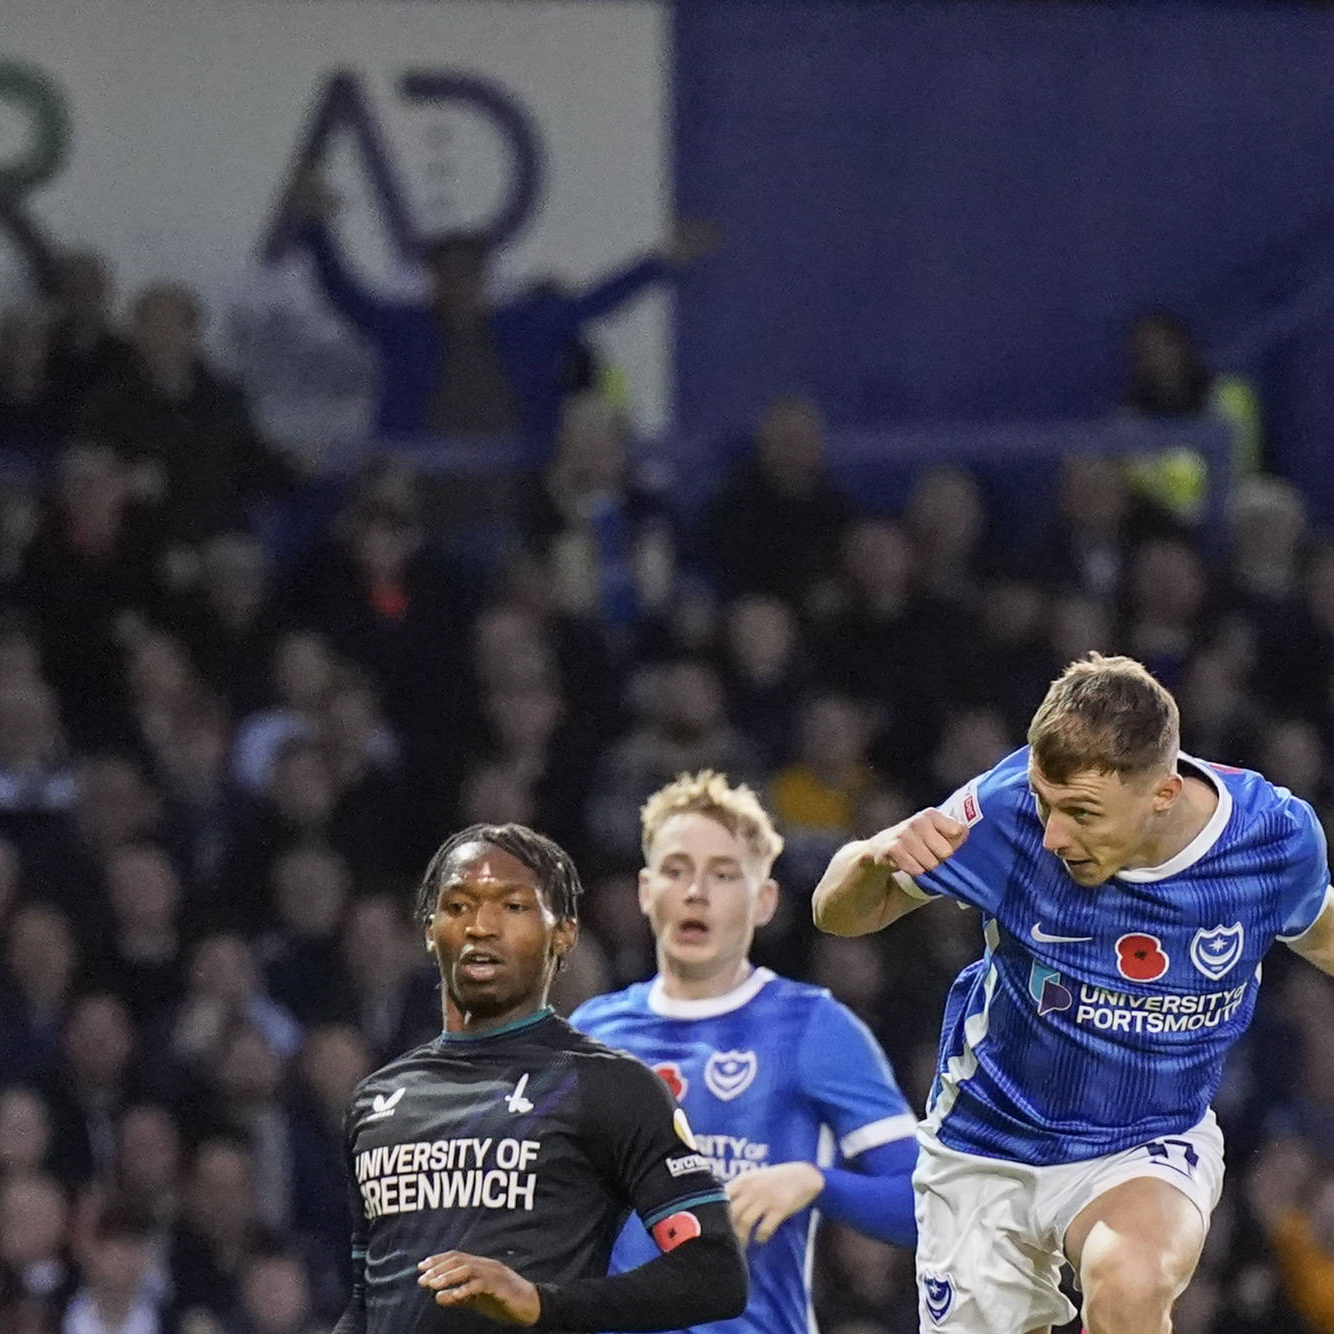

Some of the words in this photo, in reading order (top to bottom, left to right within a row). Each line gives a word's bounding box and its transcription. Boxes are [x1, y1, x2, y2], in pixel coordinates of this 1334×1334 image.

[1080, 984, 1236, 1014] UNIVERSITY
[355, 1138, 493, 1184] UNIVERSITY
[496, 1138, 540, 1171] OF
